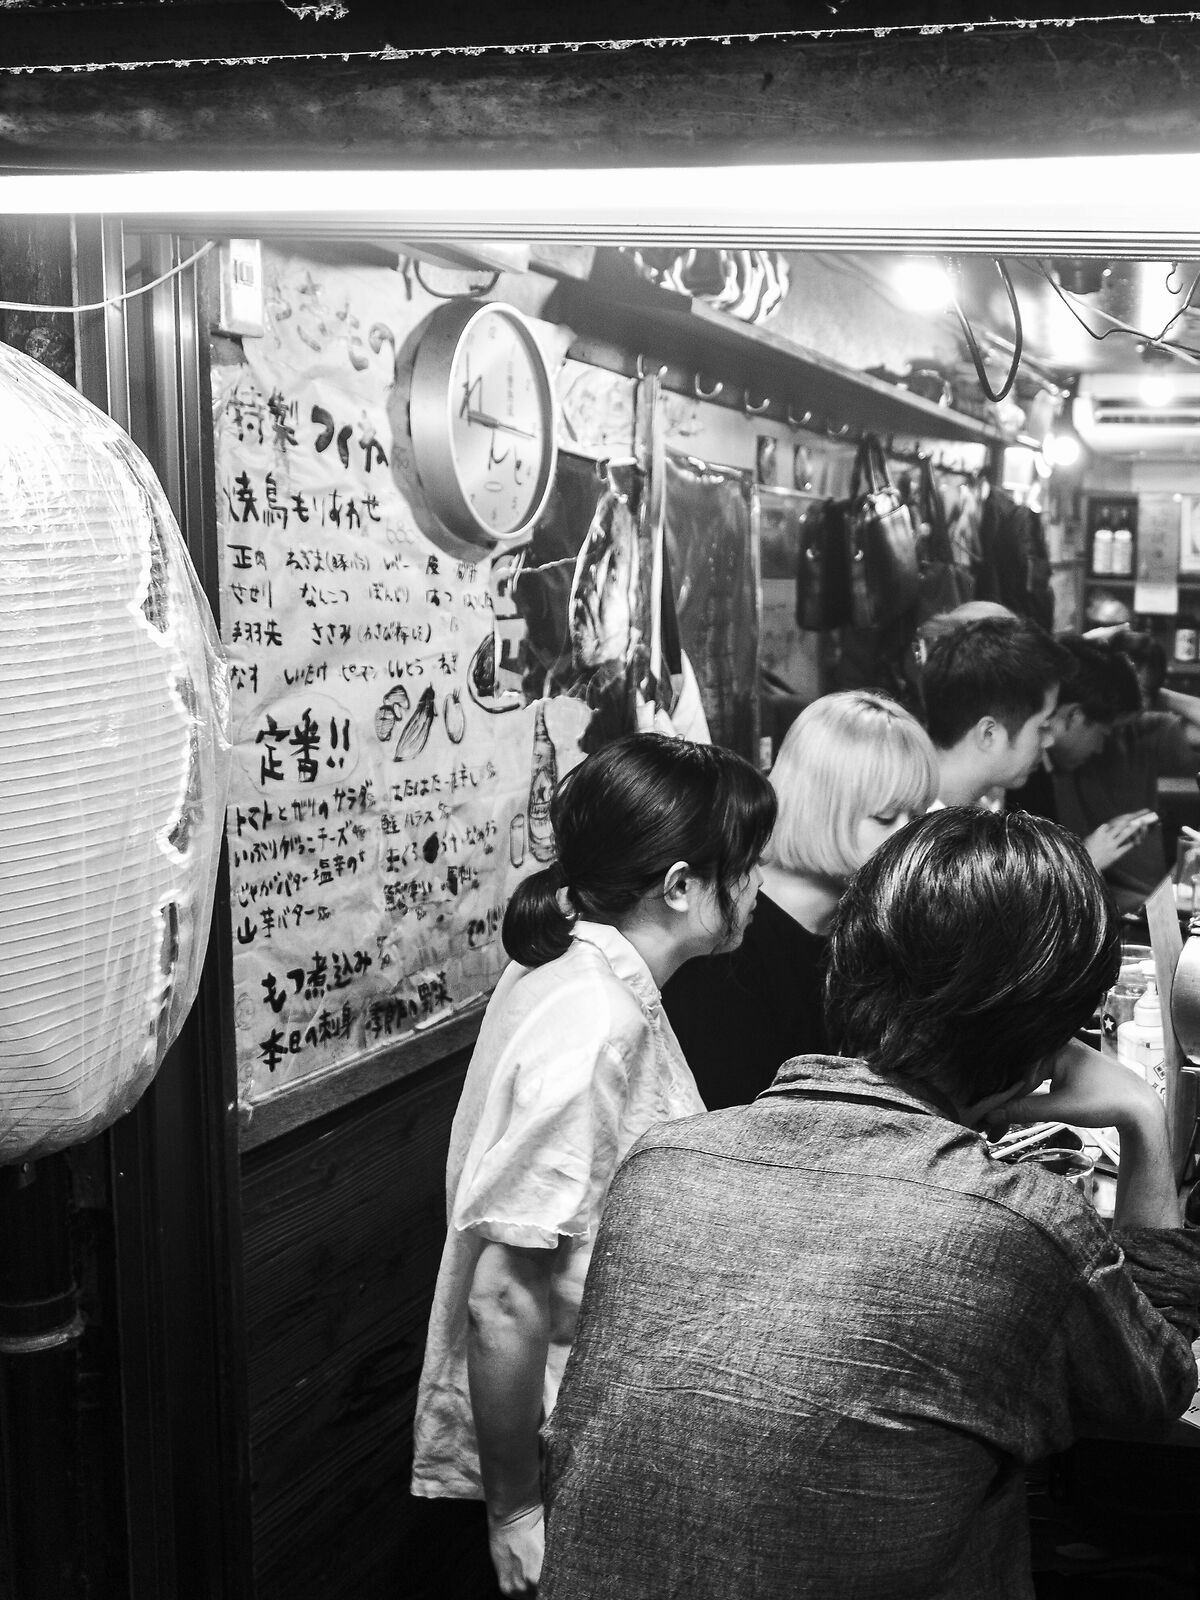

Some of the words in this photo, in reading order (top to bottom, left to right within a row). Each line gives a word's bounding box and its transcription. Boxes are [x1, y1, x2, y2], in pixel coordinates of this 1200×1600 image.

[299, 582, 349, 608] なんこつ
[231, 620, 283, 647] 手羽先
[229, 663, 258, 694] なす
[283, 661, 328, 685] しいたけ
[237, 903, 316, 945] 山芋バター
[261, 950, 372, 1014] もつ煮込み
[257, 1000, 357, 1073] 本日の刺身
